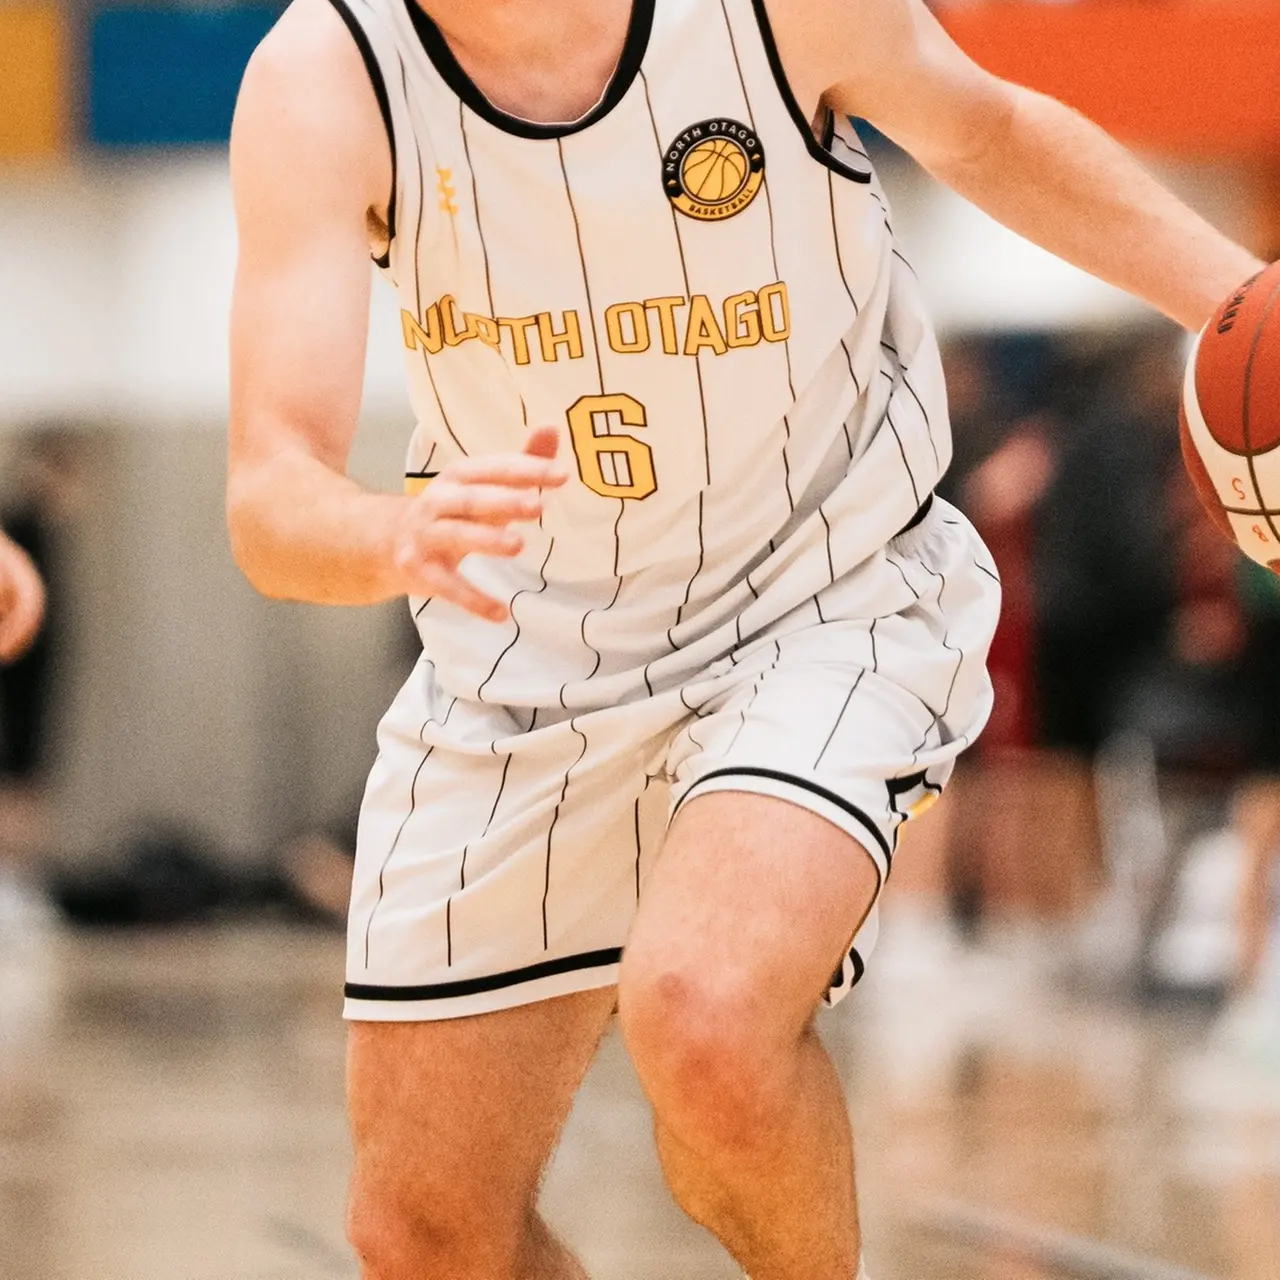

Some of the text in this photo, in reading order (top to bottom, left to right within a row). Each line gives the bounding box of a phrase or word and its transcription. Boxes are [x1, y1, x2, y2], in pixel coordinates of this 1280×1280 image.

[666, 122, 756, 172] NORTH OTAGO
[688, 188, 754, 216] BASKETBALL
[604, 281, 791, 357] OTAGO
[566, 393, 658, 501] 6
